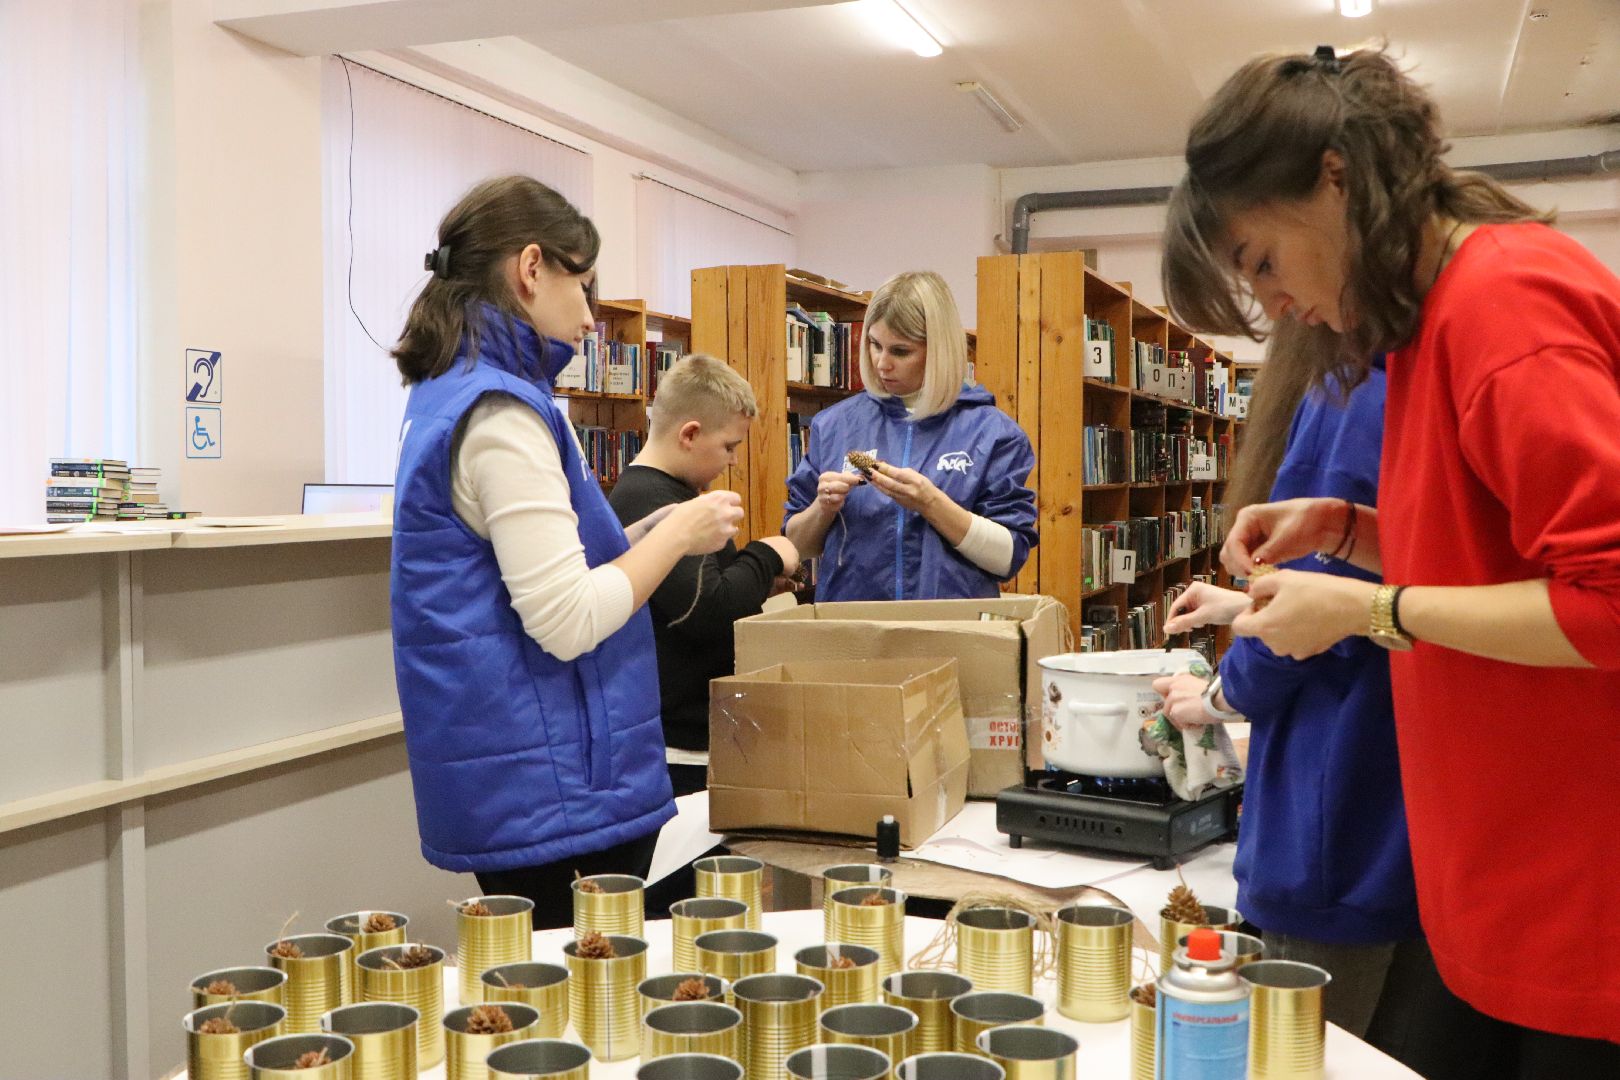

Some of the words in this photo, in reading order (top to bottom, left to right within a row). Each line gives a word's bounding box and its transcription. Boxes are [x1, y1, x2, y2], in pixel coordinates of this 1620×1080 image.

[1093, 346, 1102, 364] З
[1168, 373, 1175, 387] П
[1122, 555, 1131, 570] Л
[989, 721, 1019, 732] ОСТО
